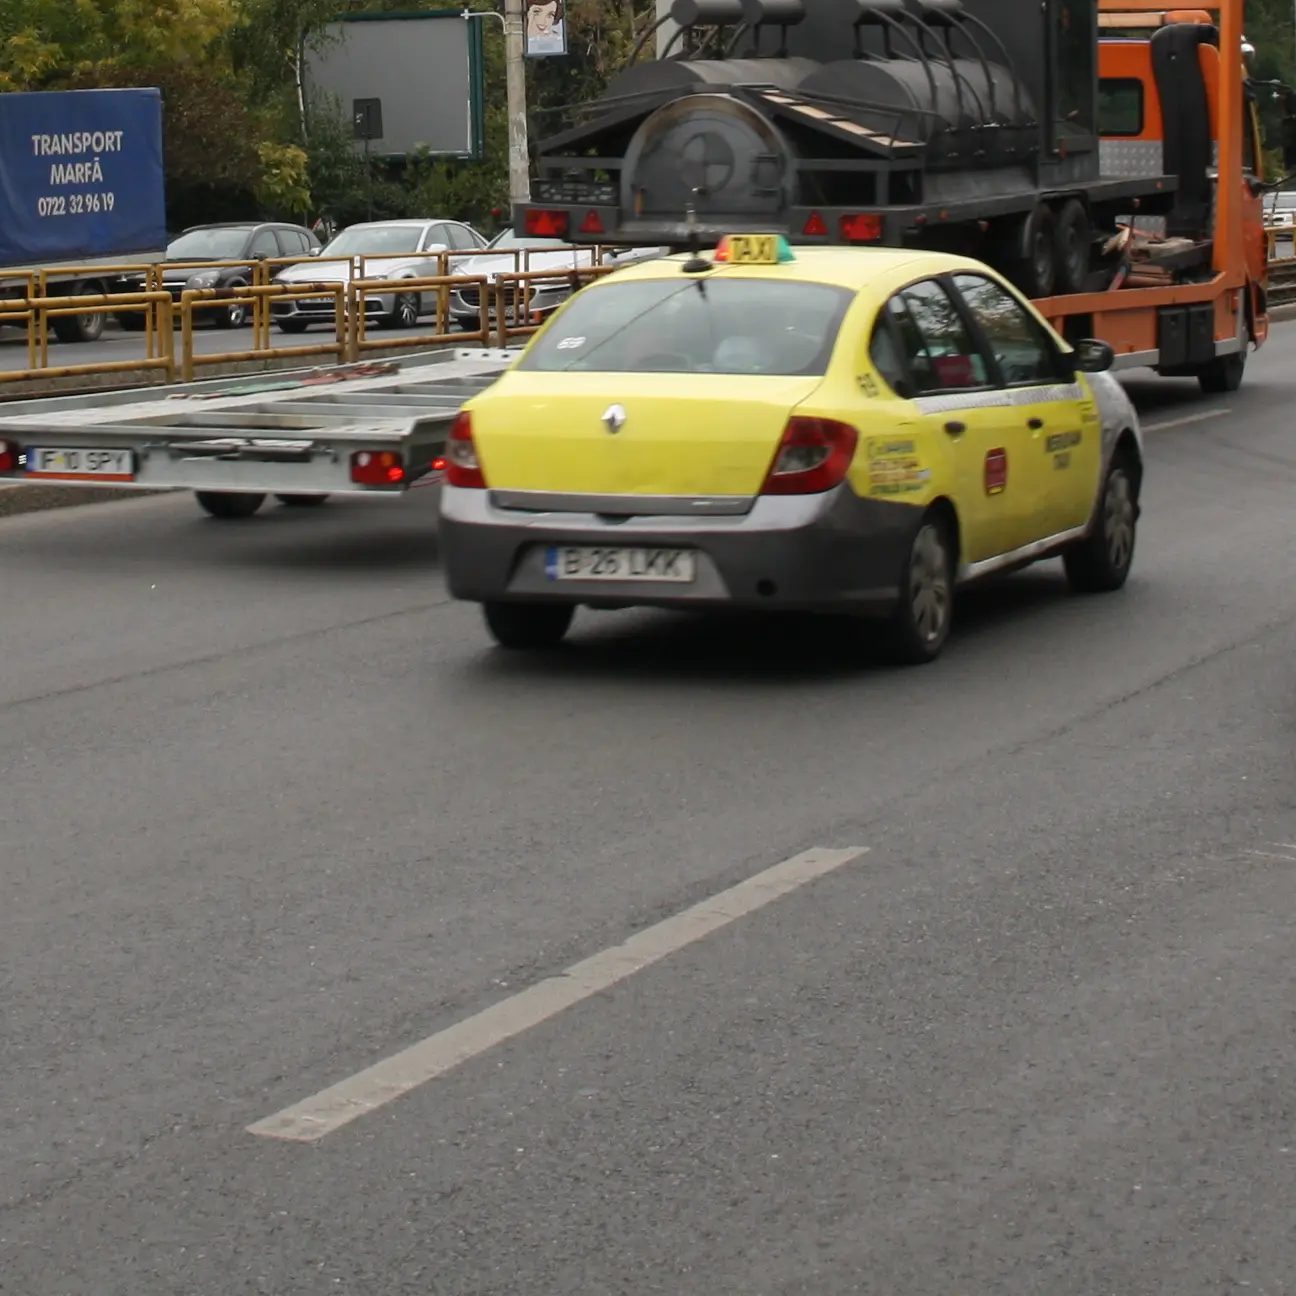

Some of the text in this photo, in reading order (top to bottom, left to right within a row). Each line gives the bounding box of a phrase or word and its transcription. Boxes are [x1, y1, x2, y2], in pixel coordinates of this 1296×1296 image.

[31, 131, 124, 156] TRANSPORT
[50, 156, 103, 185] MARFĂ
[38, 191, 115, 216] 0722 32 96 19
[730, 236, 774, 260] TAXI
[85, 452, 126, 471] SPY
[564, 548, 581, 575] B
[628, 549, 683, 577] LKK
